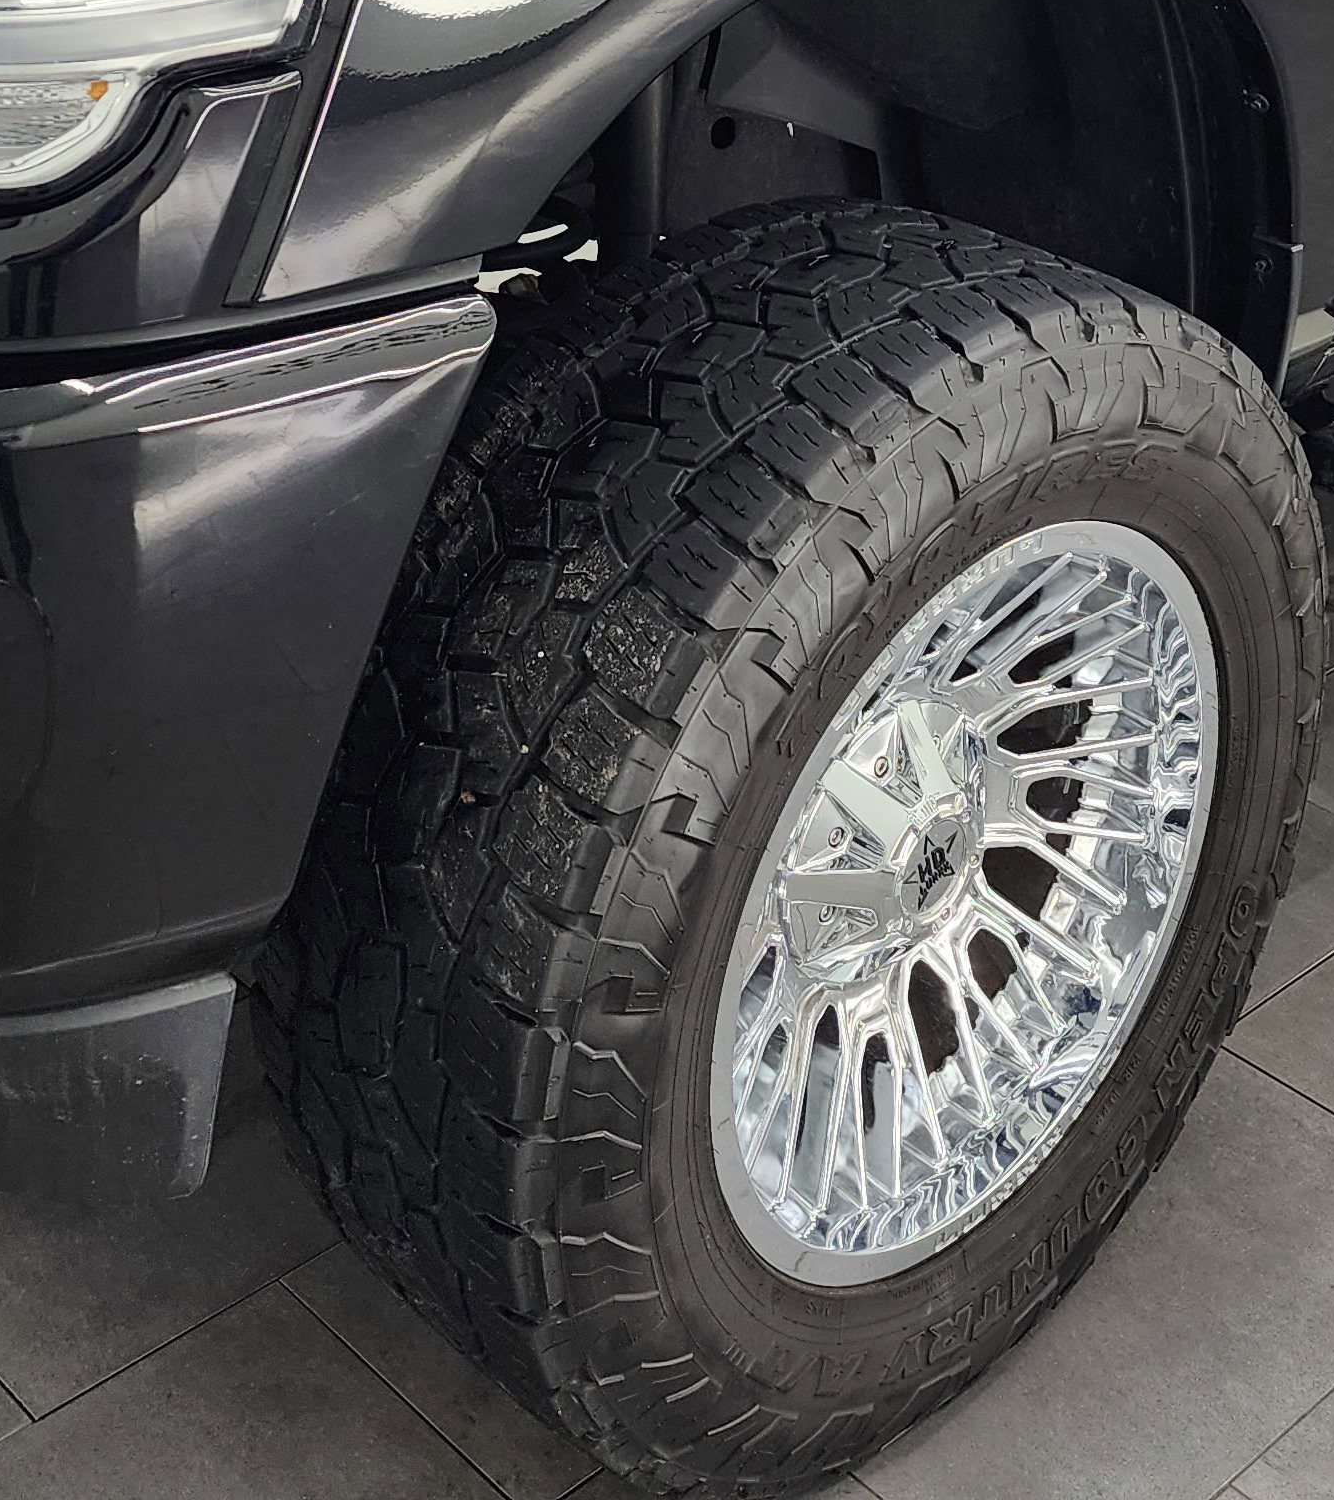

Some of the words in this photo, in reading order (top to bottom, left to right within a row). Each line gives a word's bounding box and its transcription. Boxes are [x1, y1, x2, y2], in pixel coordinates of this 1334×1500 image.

[774, 518, 959, 758] TOYO
[971, 442, 1175, 534] TIRES
[918, 846, 947, 884] HD
[1151, 882, 1261, 1112] OPEN
[878, 1114, 1151, 1386] COUNTRY
